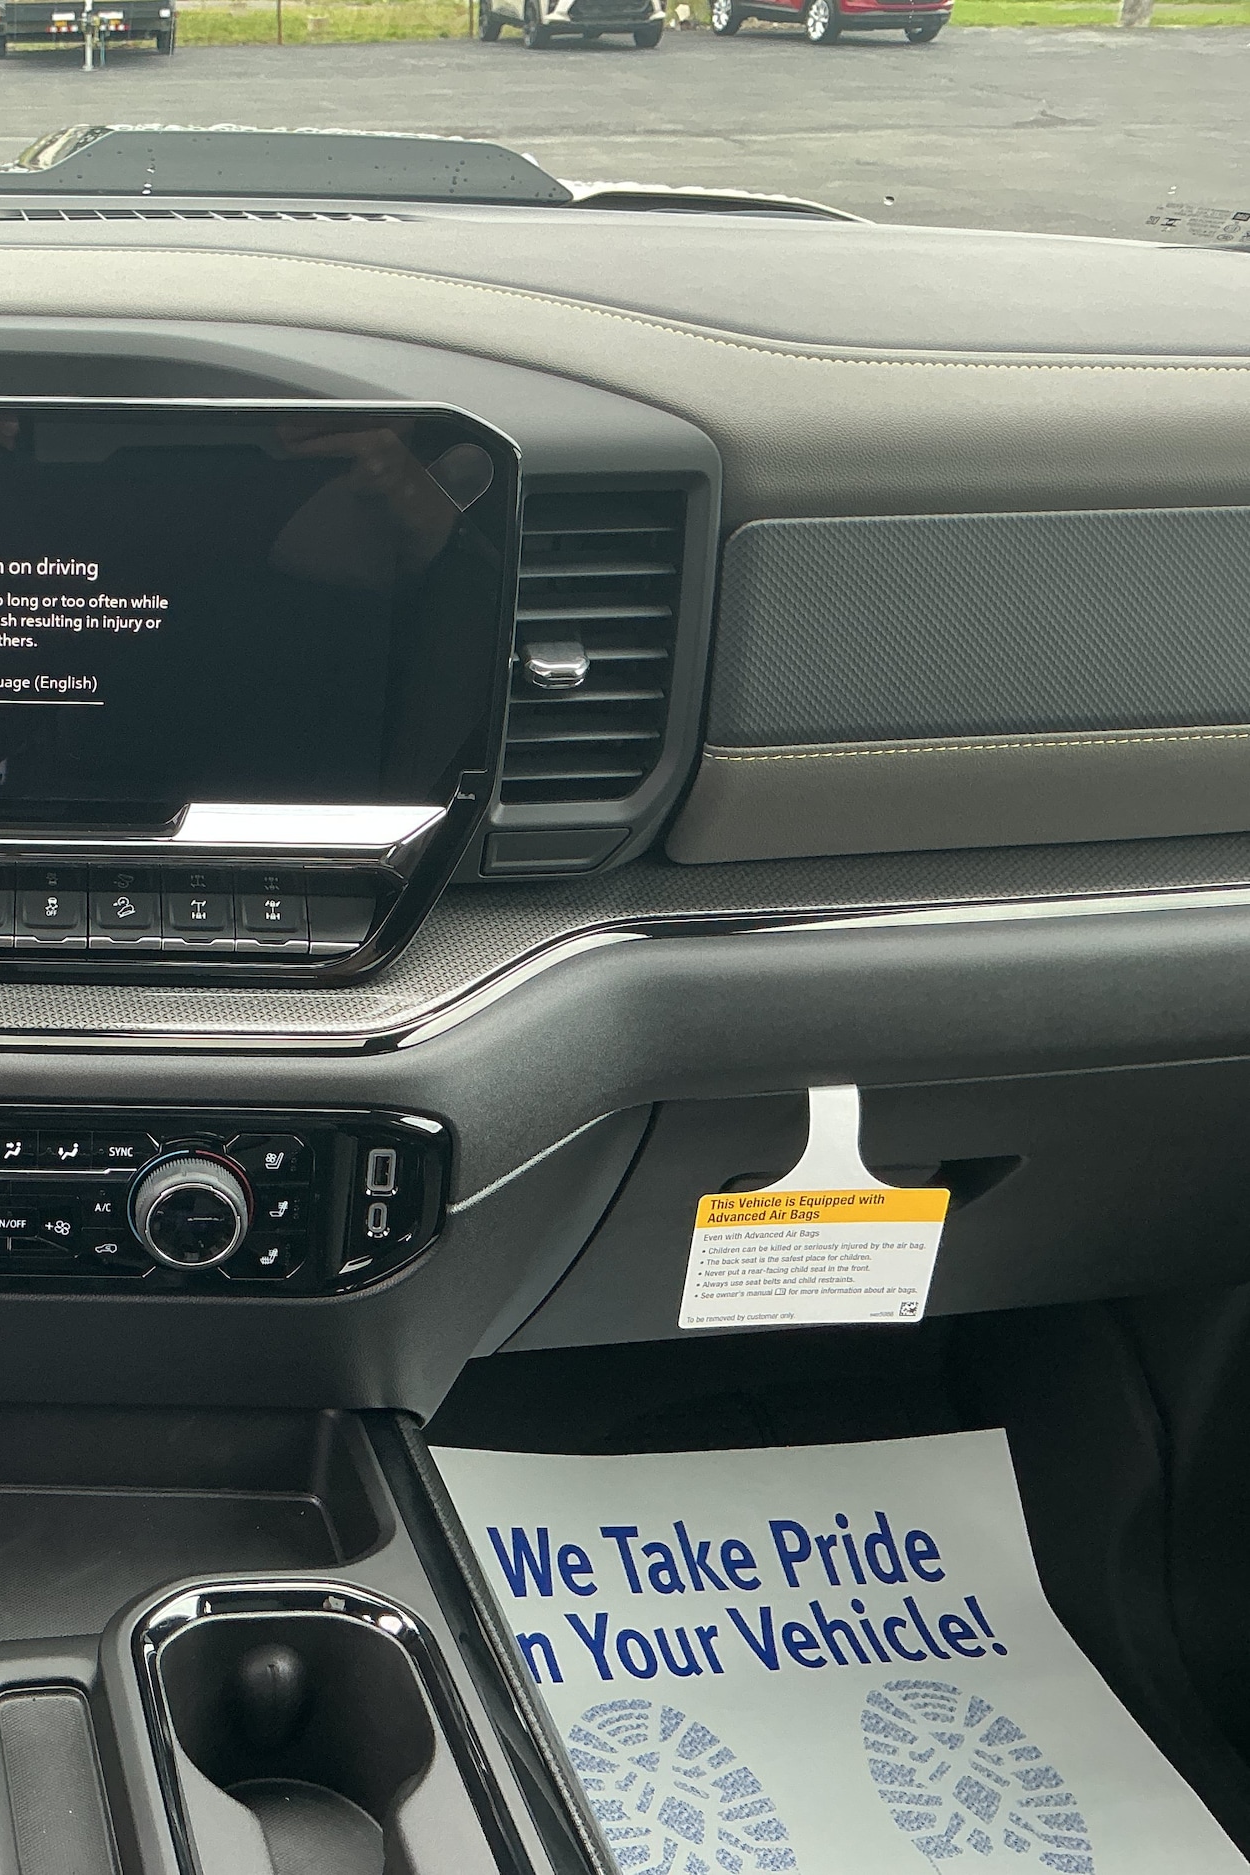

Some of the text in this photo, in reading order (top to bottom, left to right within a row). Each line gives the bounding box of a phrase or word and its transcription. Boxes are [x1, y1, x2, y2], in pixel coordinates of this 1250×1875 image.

[9, 562, 31, 575] on
[37, 557, 98, 580] driving
[8, 593, 38, 610] long
[42, 596, 58, 607] or
[61, 595, 85, 608] too
[89, 594, 127, 608] often
[130, 595, 168, 609] while
[21, 614, 82, 631] resulting
[87, 615, 98, 628] in
[103, 615, 142, 632] injury
[146, 618, 161, 629] or
[34, 675, 98, 692] (English)
[108, 1147, 133, 1158] SYNC
[94, 1202, 111, 1213] A/C
[711, 1194, 885, 1209] This Vehicle is Equipped with
[708, 1210, 820, 1223] Advanced Air Bags
[725, 1232, 742, 1240] with
[744, 1230, 784, 1239] Advanced
[799, 1230, 820, 1238] Bags
[709, 1246, 739, 1254] Children
[806, 1254, 825, 1262] place
[748, 1267, 788, 1275] rear-facing
[703, 1280, 728, 1288] Always
[706, 1314, 735, 1322] removed
[487, 1511, 946, 1598] We Take Pride
[516, 1595, 1008, 1684] n Your Vehicle!
